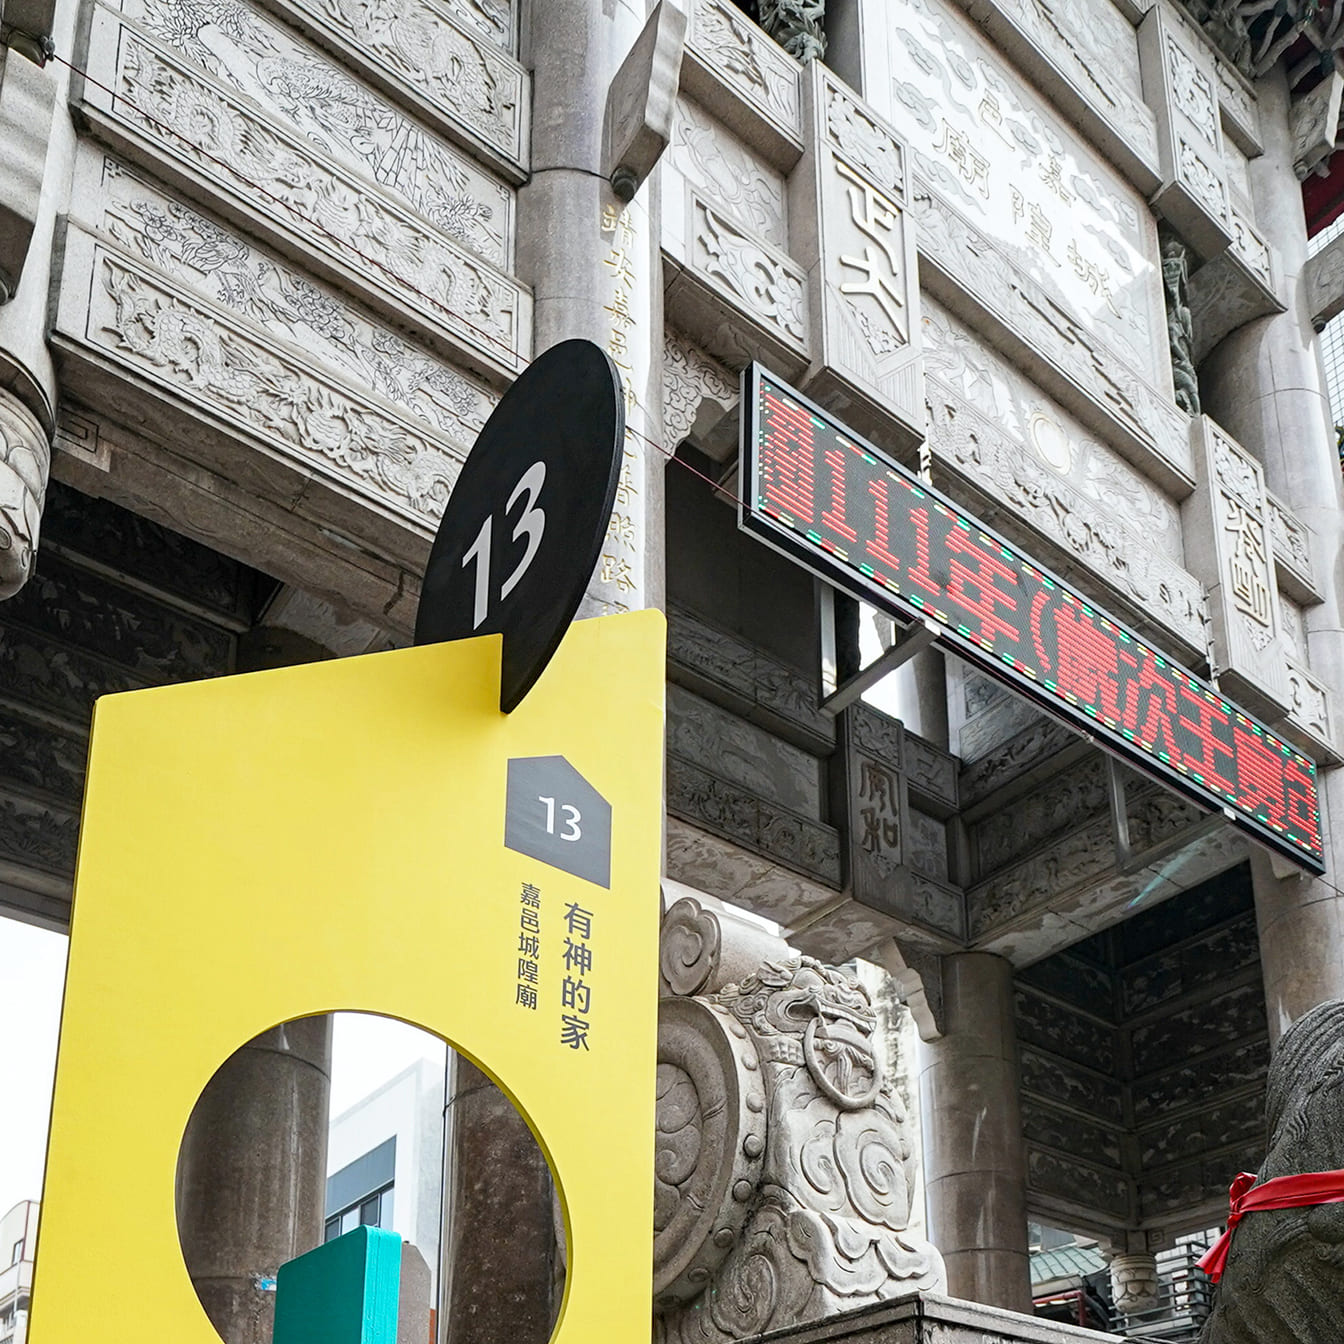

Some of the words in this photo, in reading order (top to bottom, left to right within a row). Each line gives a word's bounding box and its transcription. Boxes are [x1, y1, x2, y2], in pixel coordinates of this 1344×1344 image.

[462, 461, 546, 630] 13
[538, 795, 582, 842] 13
[515, 882, 541, 1010] 嘉邑城隍廟
[560, 901, 594, 1051] 有神的家
